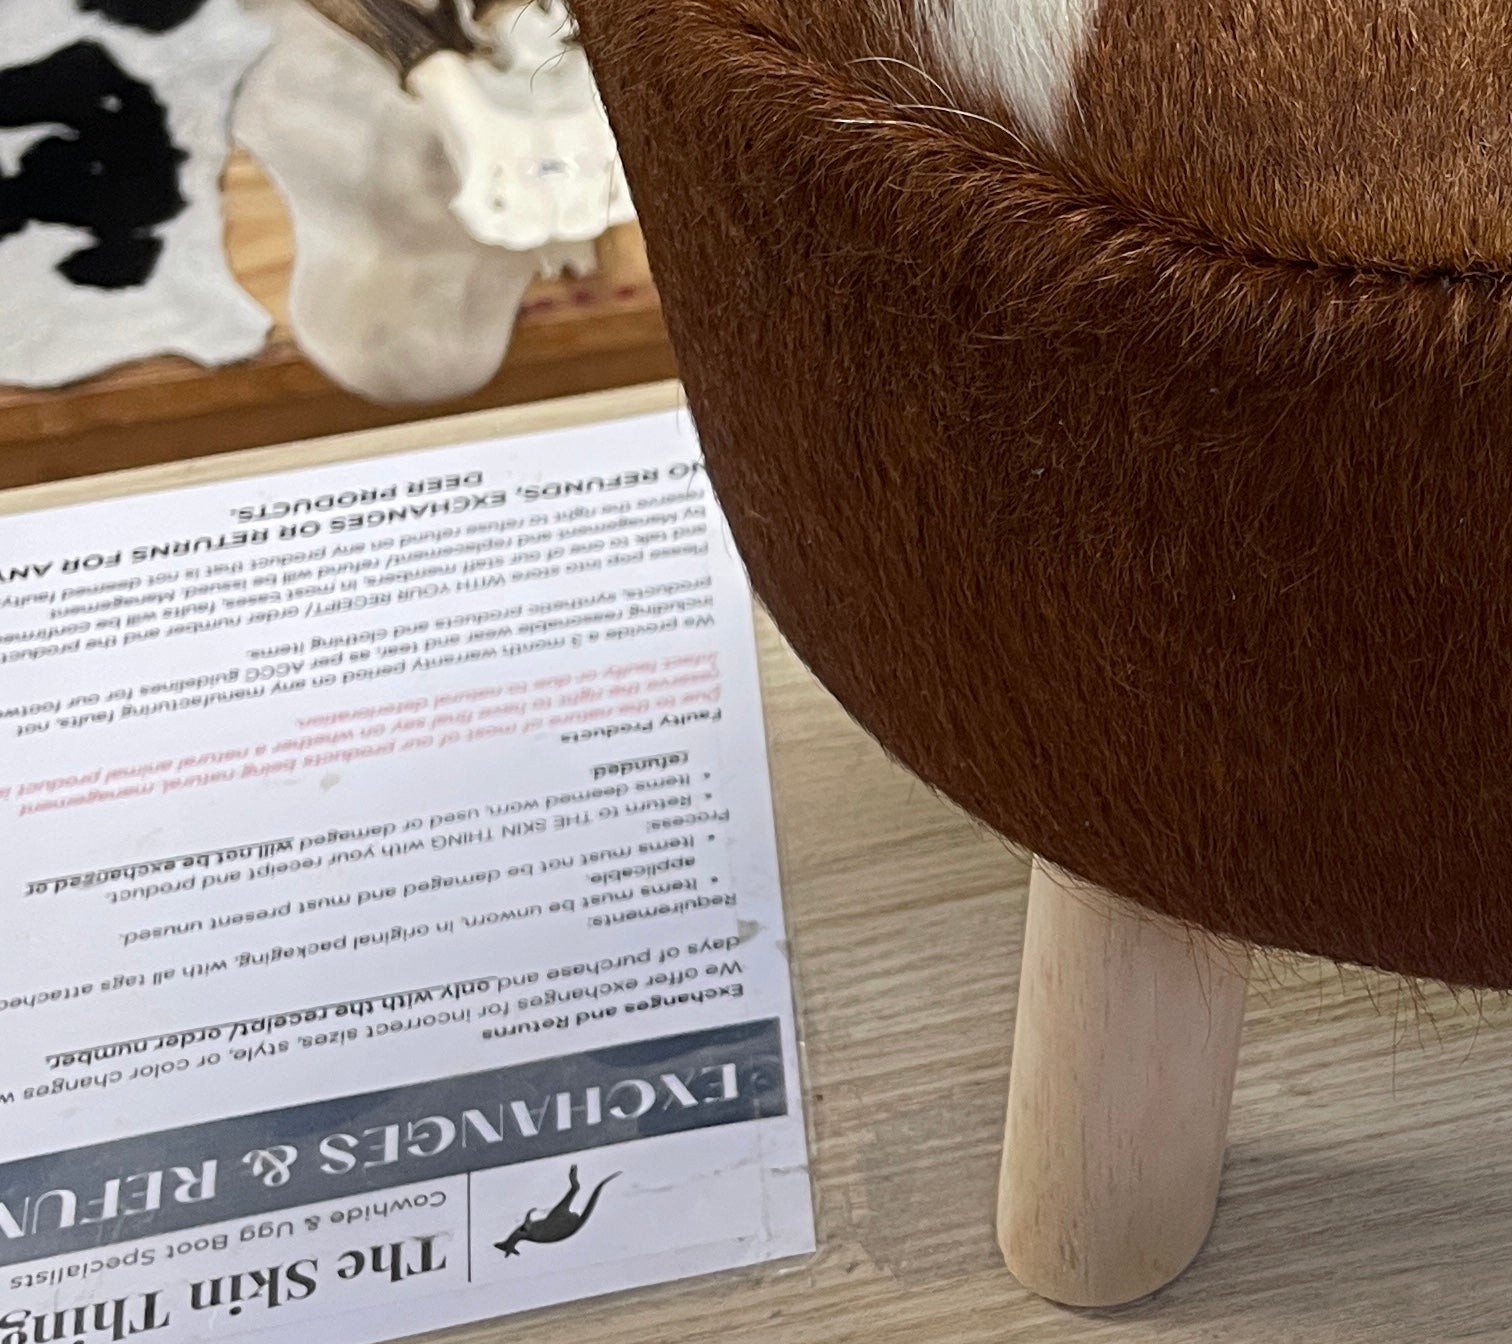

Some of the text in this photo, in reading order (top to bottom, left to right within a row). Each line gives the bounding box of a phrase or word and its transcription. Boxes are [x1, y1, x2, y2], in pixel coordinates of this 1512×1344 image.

[407, 471, 483, 498] DEER
[330, 492, 507, 534] EXCHANGES
[279, 521, 322, 542] OR
[132, 529, 270, 565] RETURNS
[61, 551, 122, 576] FOR
[658, 946, 681, 963] of
[687, 936, 741, 954] days
[546, 947, 652, 980] purchase
[705, 960, 742, 977] We
[439, 980, 491, 999] only
[497, 972, 540, 992] and
[645, 968, 699, 987] offer
[381, 990, 434, 1012] with
[517, 979, 639, 1010] exchanges
[334, 1001, 375, 1018] the
[478, 1002, 510, 1017] for
[483, 984, 744, 1041] Exchanges and Returns
[228, 1009, 328, 1040] receipt/
[366, 1009, 472, 1040] incorrect
[153, 1028, 222, 1050] order
[129, 1059, 191, 1080] color
[197, 1054, 222, 1068] or
[23, 1072, 123, 1099] changes
[319, 1061, 738, 1175] EXCHANGES
[244, 1145, 299, 1190] &
[11, 1192, 447, 1289] Cowhide & Ugg Boot Specialists
[336, 1233, 448, 1283] The
[189, 1259, 321, 1313] Skin
